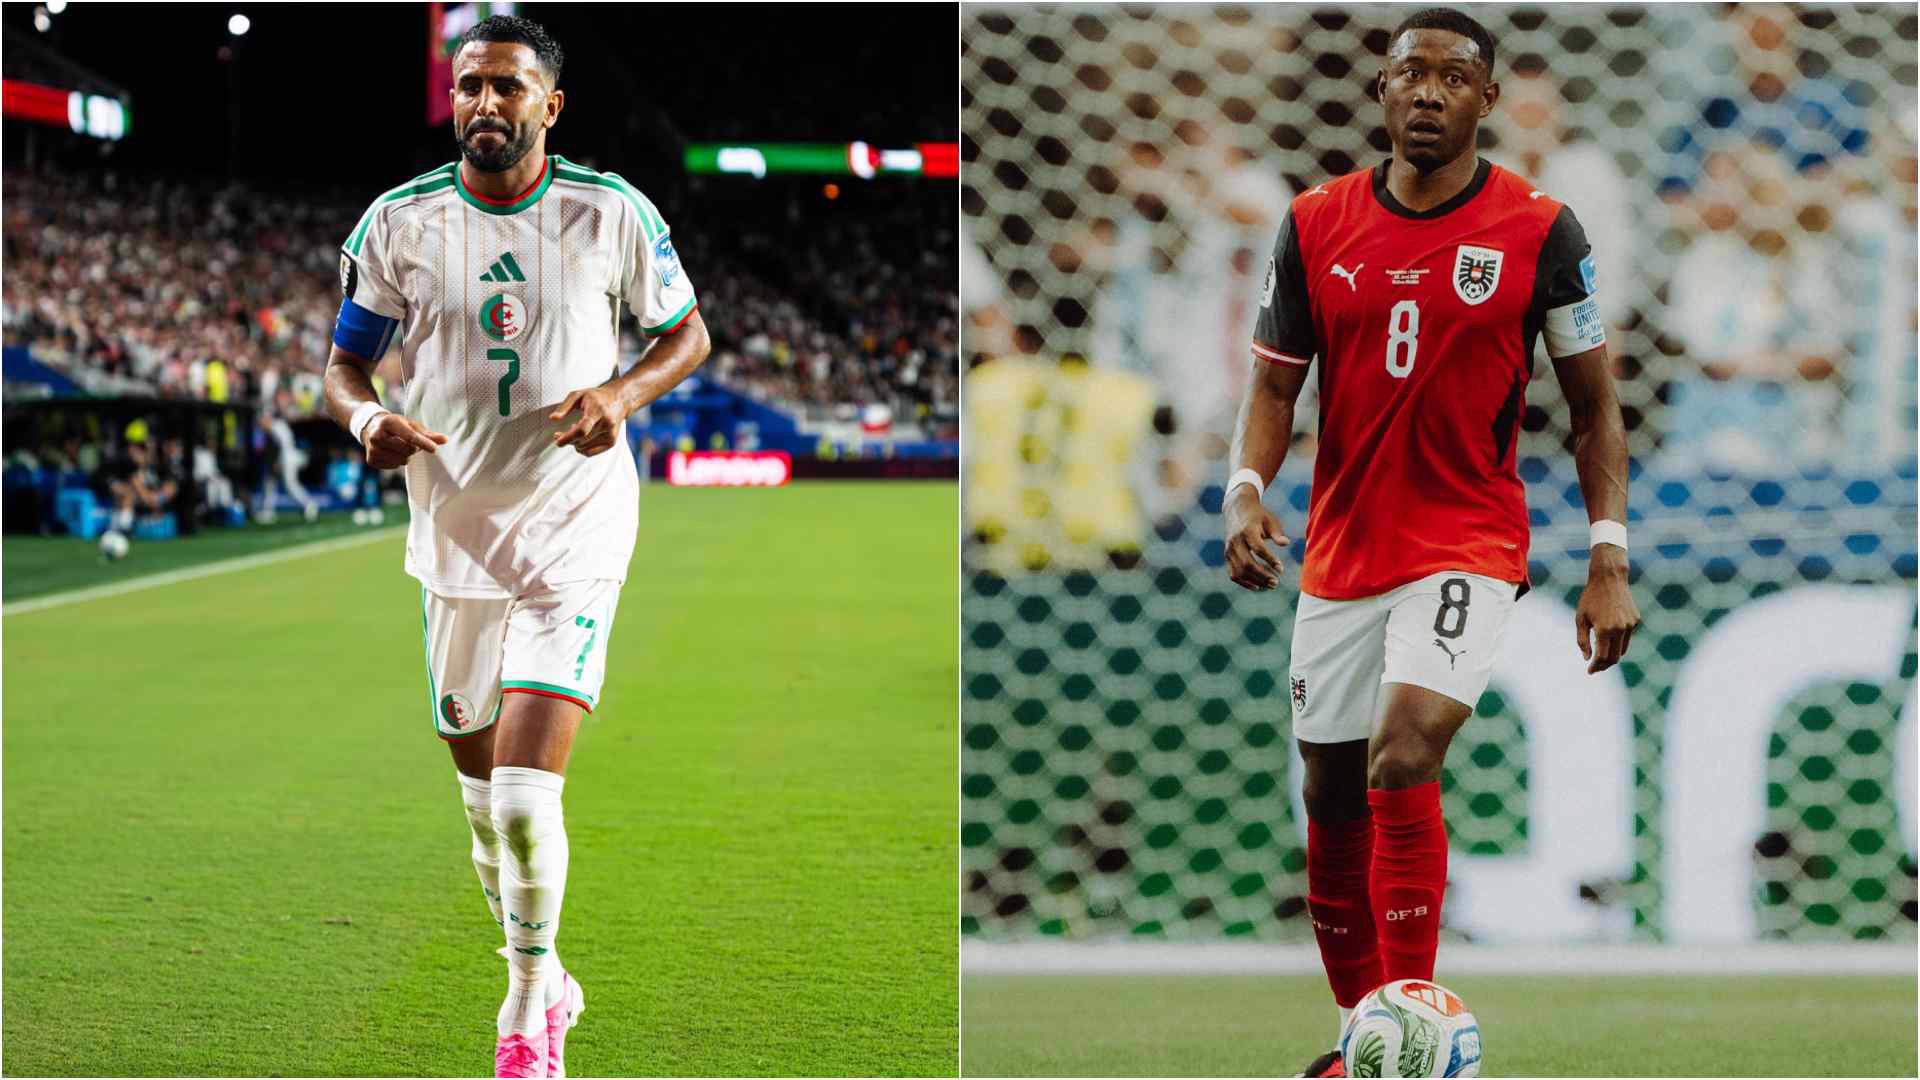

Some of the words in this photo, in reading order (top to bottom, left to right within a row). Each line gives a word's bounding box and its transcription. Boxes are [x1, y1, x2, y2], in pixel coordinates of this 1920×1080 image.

[1385, 299, 1420, 378] 8
[486, 348, 521, 417] 7
[1433, 578, 1471, 639] 8
[574, 615, 597, 681] 7
[1385, 905, 1428, 921] ÖFB
